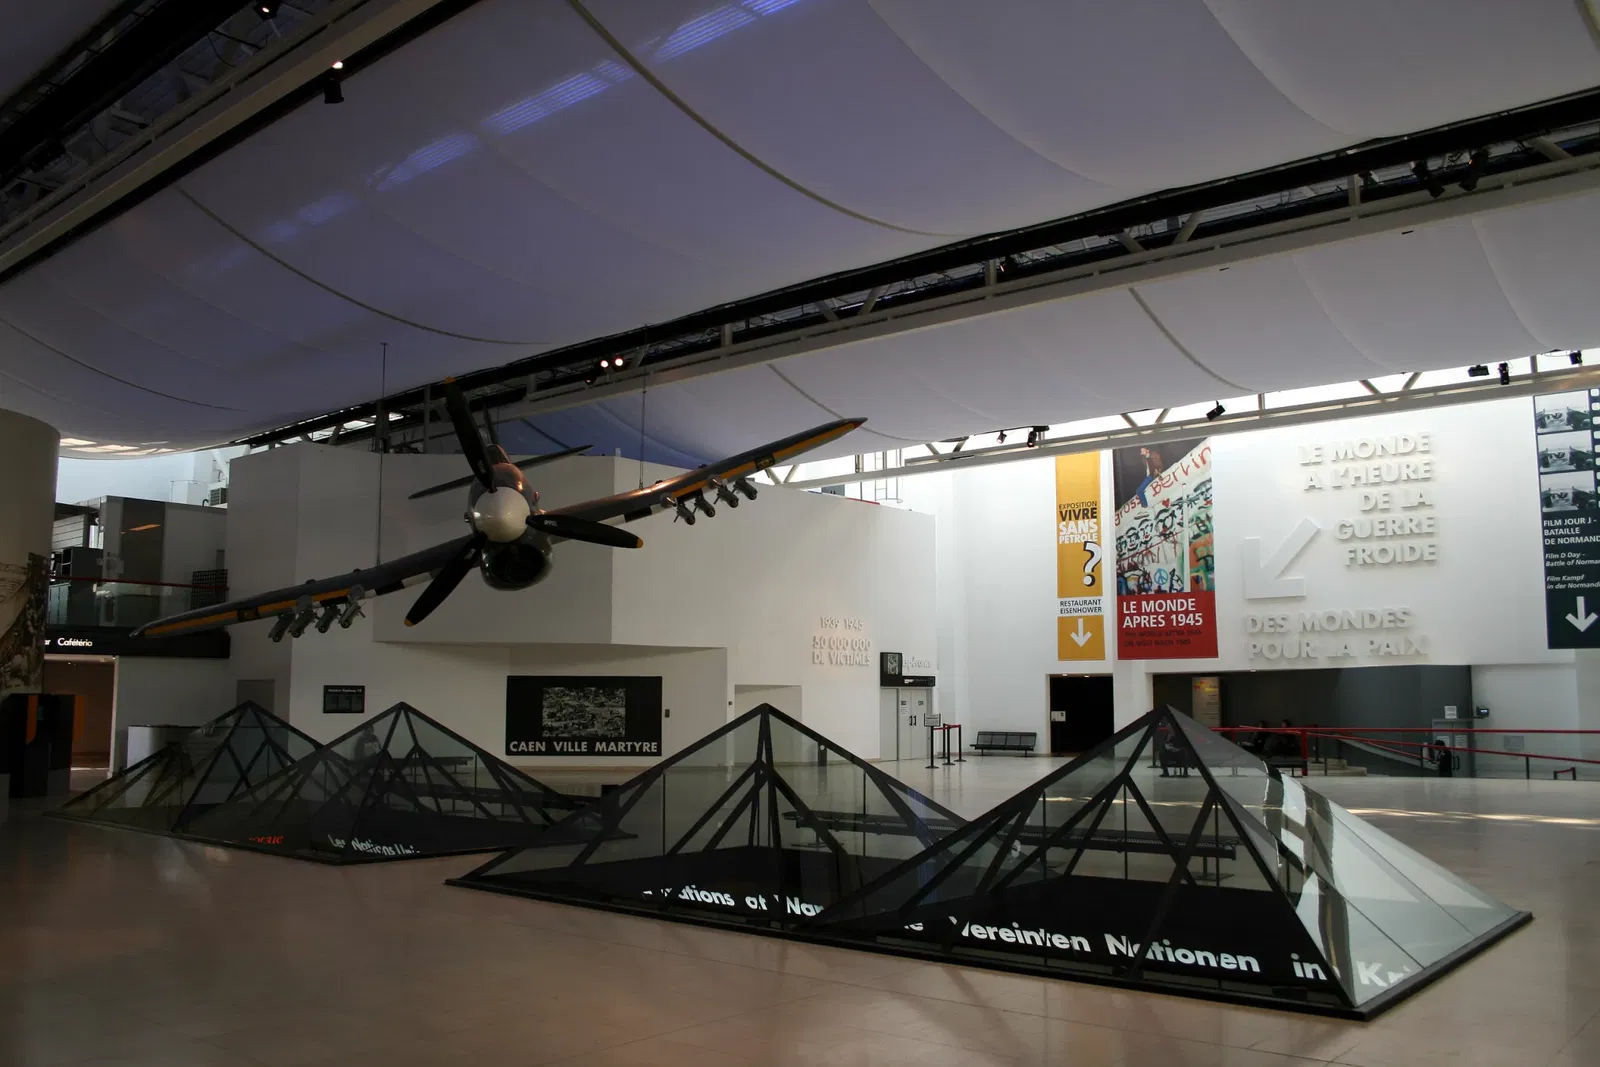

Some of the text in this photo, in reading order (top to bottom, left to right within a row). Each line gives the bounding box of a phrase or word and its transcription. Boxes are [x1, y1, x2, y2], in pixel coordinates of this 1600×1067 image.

[1300, 432, 1430, 466] LE MONDE
[1304, 460, 1434, 490] A L'HEURE
[1059, 501, 1097, 510] EXPOSITION
[1360, 487, 1433, 512] DE LA
[1059, 507, 1097, 521] VIVRE
[1564, 517, 1586, 526] JOUR
[1059, 519, 1098, 536] SANS
[1335, 516, 1435, 541] GUERRE
[1544, 527, 1580, 536] BATAILLE
[1345, 544, 1437, 566] FROIDE
[1567, 552, 1581, 560] Day
[1562, 573, 1585, 583] Kampf
[1060, 599, 1101, 607] RESTAURANT
[1123, 599, 1196, 614] LE MONDE
[1060, 607, 1102, 615] EISENHOWER
[820, 616, 864, 631] 1939 1945
[1123, 613, 1203, 628] APRES 1945
[1247, 606, 1412, 634] DES MONDES
[57, 637, 93, 647] Cafétéria
[812, 636, 872, 652] 50 000 000
[1248, 638, 1319, 660] POUR
[1367, 634, 1430, 657] PAIX
[828, 651, 872, 667] VICTIMES
[509, 741, 658, 752] CAEN VILLE MARTYRE
